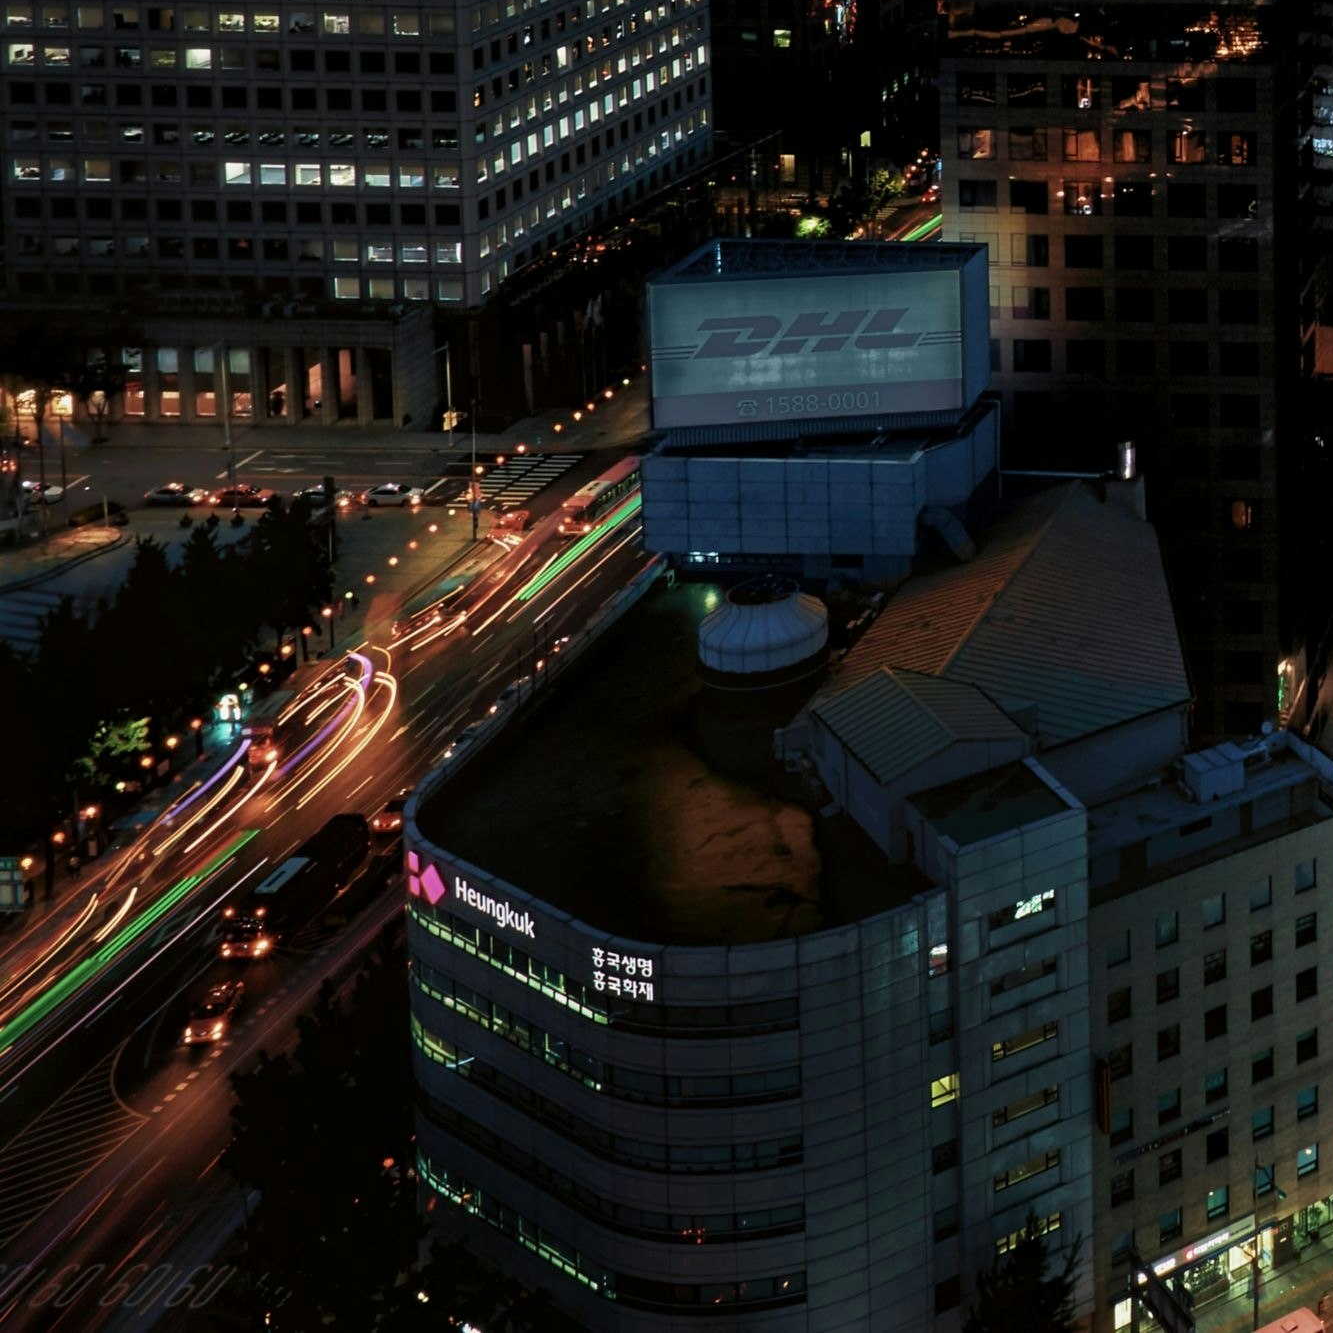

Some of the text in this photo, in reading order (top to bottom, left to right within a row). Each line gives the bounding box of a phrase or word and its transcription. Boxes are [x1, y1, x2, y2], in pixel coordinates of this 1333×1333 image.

[694, 307, 923, 360] DHL
[766, 391, 881, 420] 1588-0001
[455, 877, 536, 939] Heungkuk
[592, 947, 654, 977] 흥국생명
[592, 971, 655, 1002] 흥국화재
[99, 1263, 173, 1307] 60
[164, 1263, 238, 1309] 60
